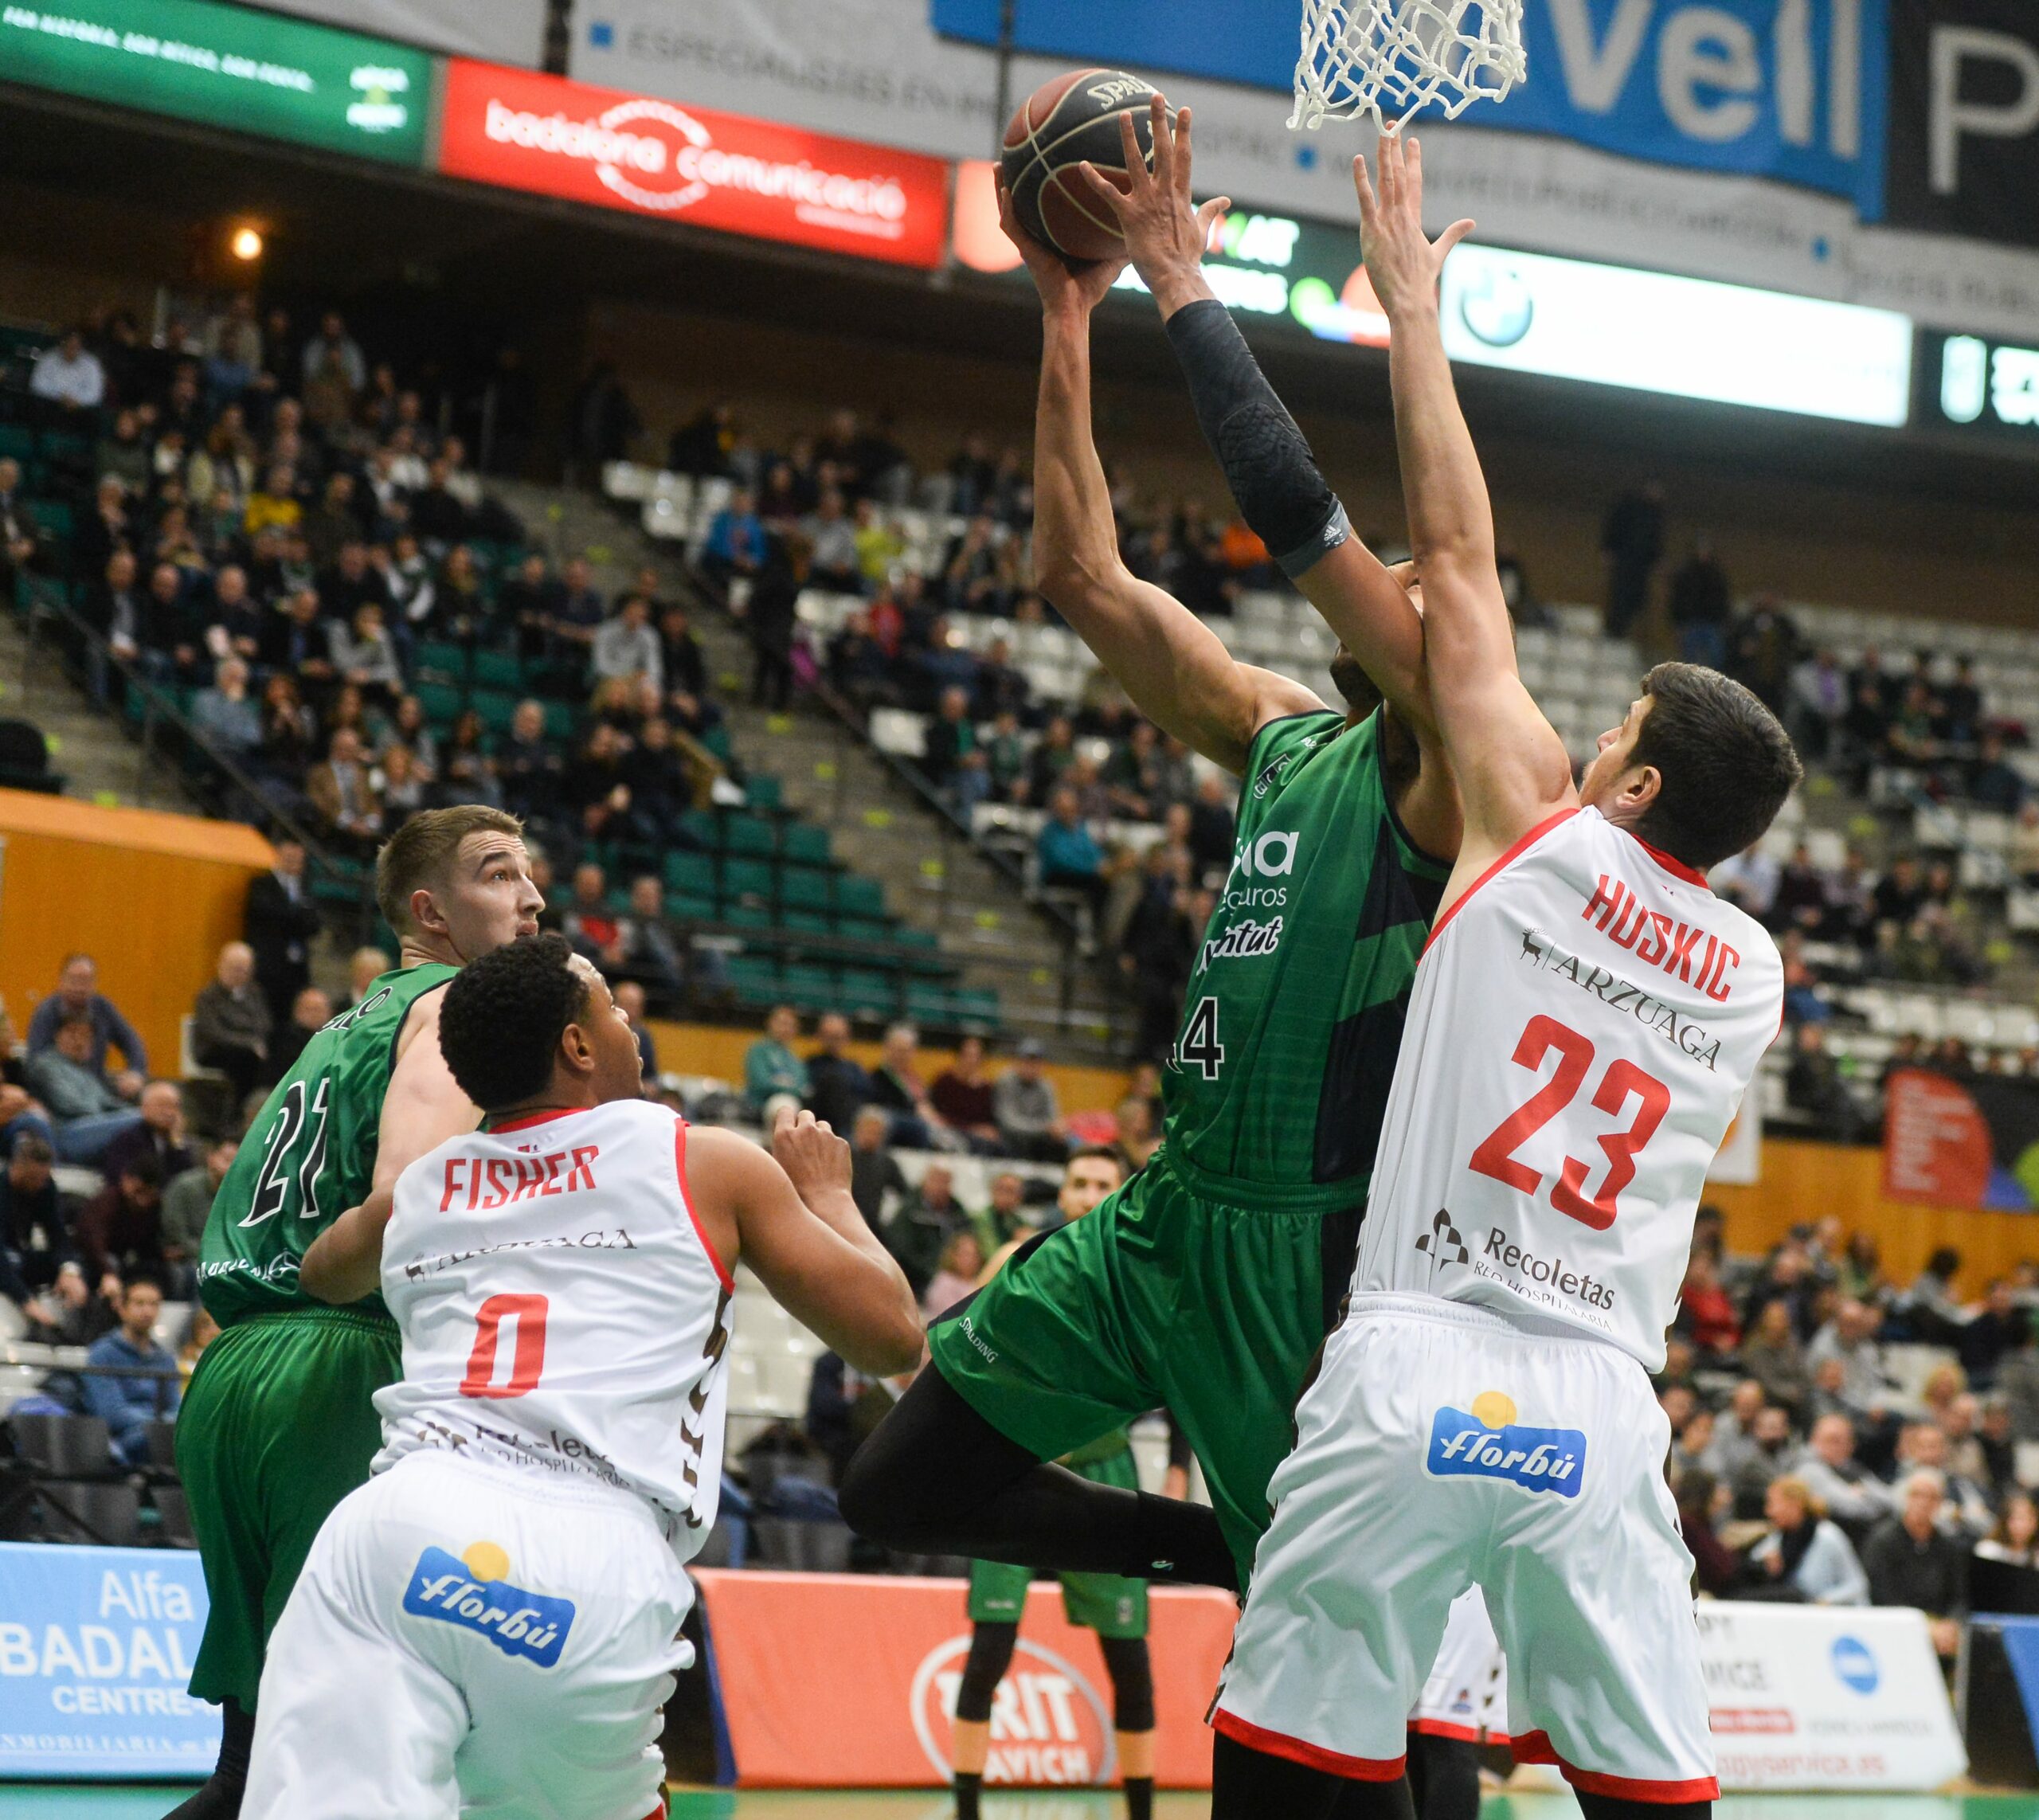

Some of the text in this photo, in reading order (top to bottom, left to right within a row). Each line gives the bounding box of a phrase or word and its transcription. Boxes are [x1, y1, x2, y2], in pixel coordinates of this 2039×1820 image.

[1581, 874, 1740, 1002] HUSKIC
[1166, 996, 1224, 1081] 4
[1551, 956, 1722, 1072] ARZUAGA
[237, 1077, 330, 1227] 21
[1469, 1014, 1671, 1231] 23
[440, 1145, 599, 1212] FISHER
[1483, 1227, 1616, 1310] Recoletas
[460, 1294, 549, 1399] 0
[959, 1317, 998, 1364] SPALDING
[1440, 1431, 1575, 1480] florbú
[99, 1569, 194, 1621] Alfa
[421, 1575, 558, 1650] florbú
[980, 1747, 1091, 1784] AVICH
